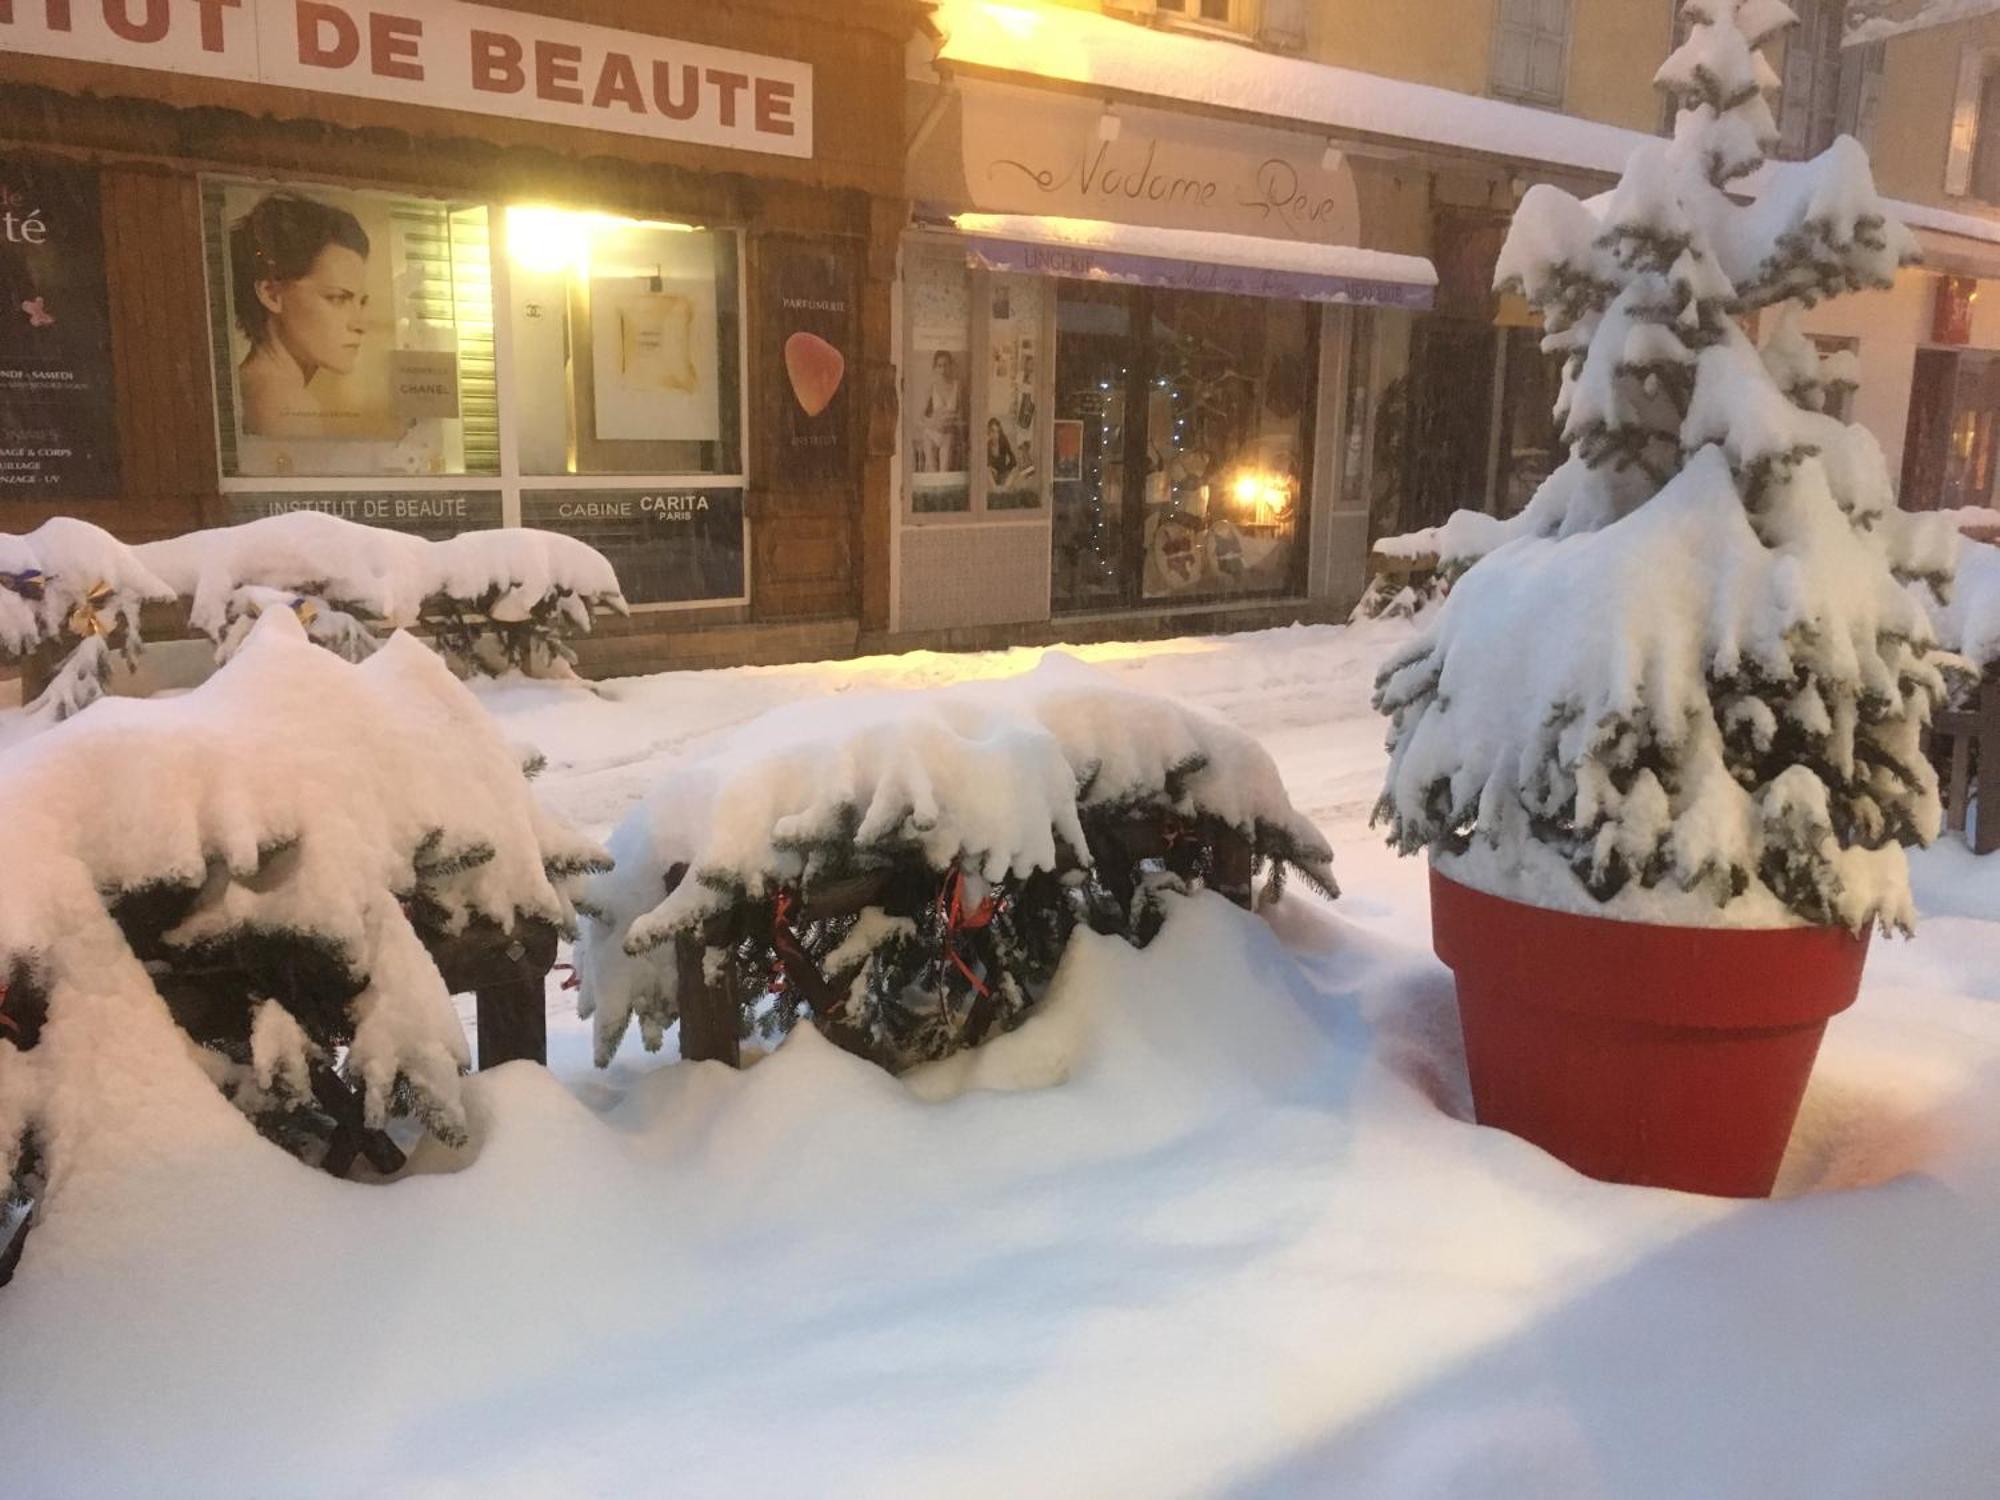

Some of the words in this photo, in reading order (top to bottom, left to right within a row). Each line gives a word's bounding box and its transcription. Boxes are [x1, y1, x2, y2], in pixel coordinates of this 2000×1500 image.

[297, 1, 425, 82] DE
[470, 29, 797, 136] BEAUTE
[268, 500, 357, 518] INSTITUT
[363, 500, 389, 518] DE
[558, 503, 632, 517] CABINE
[640, 496, 709, 511] CARITA
[659, 511, 692, 521] PARIS
